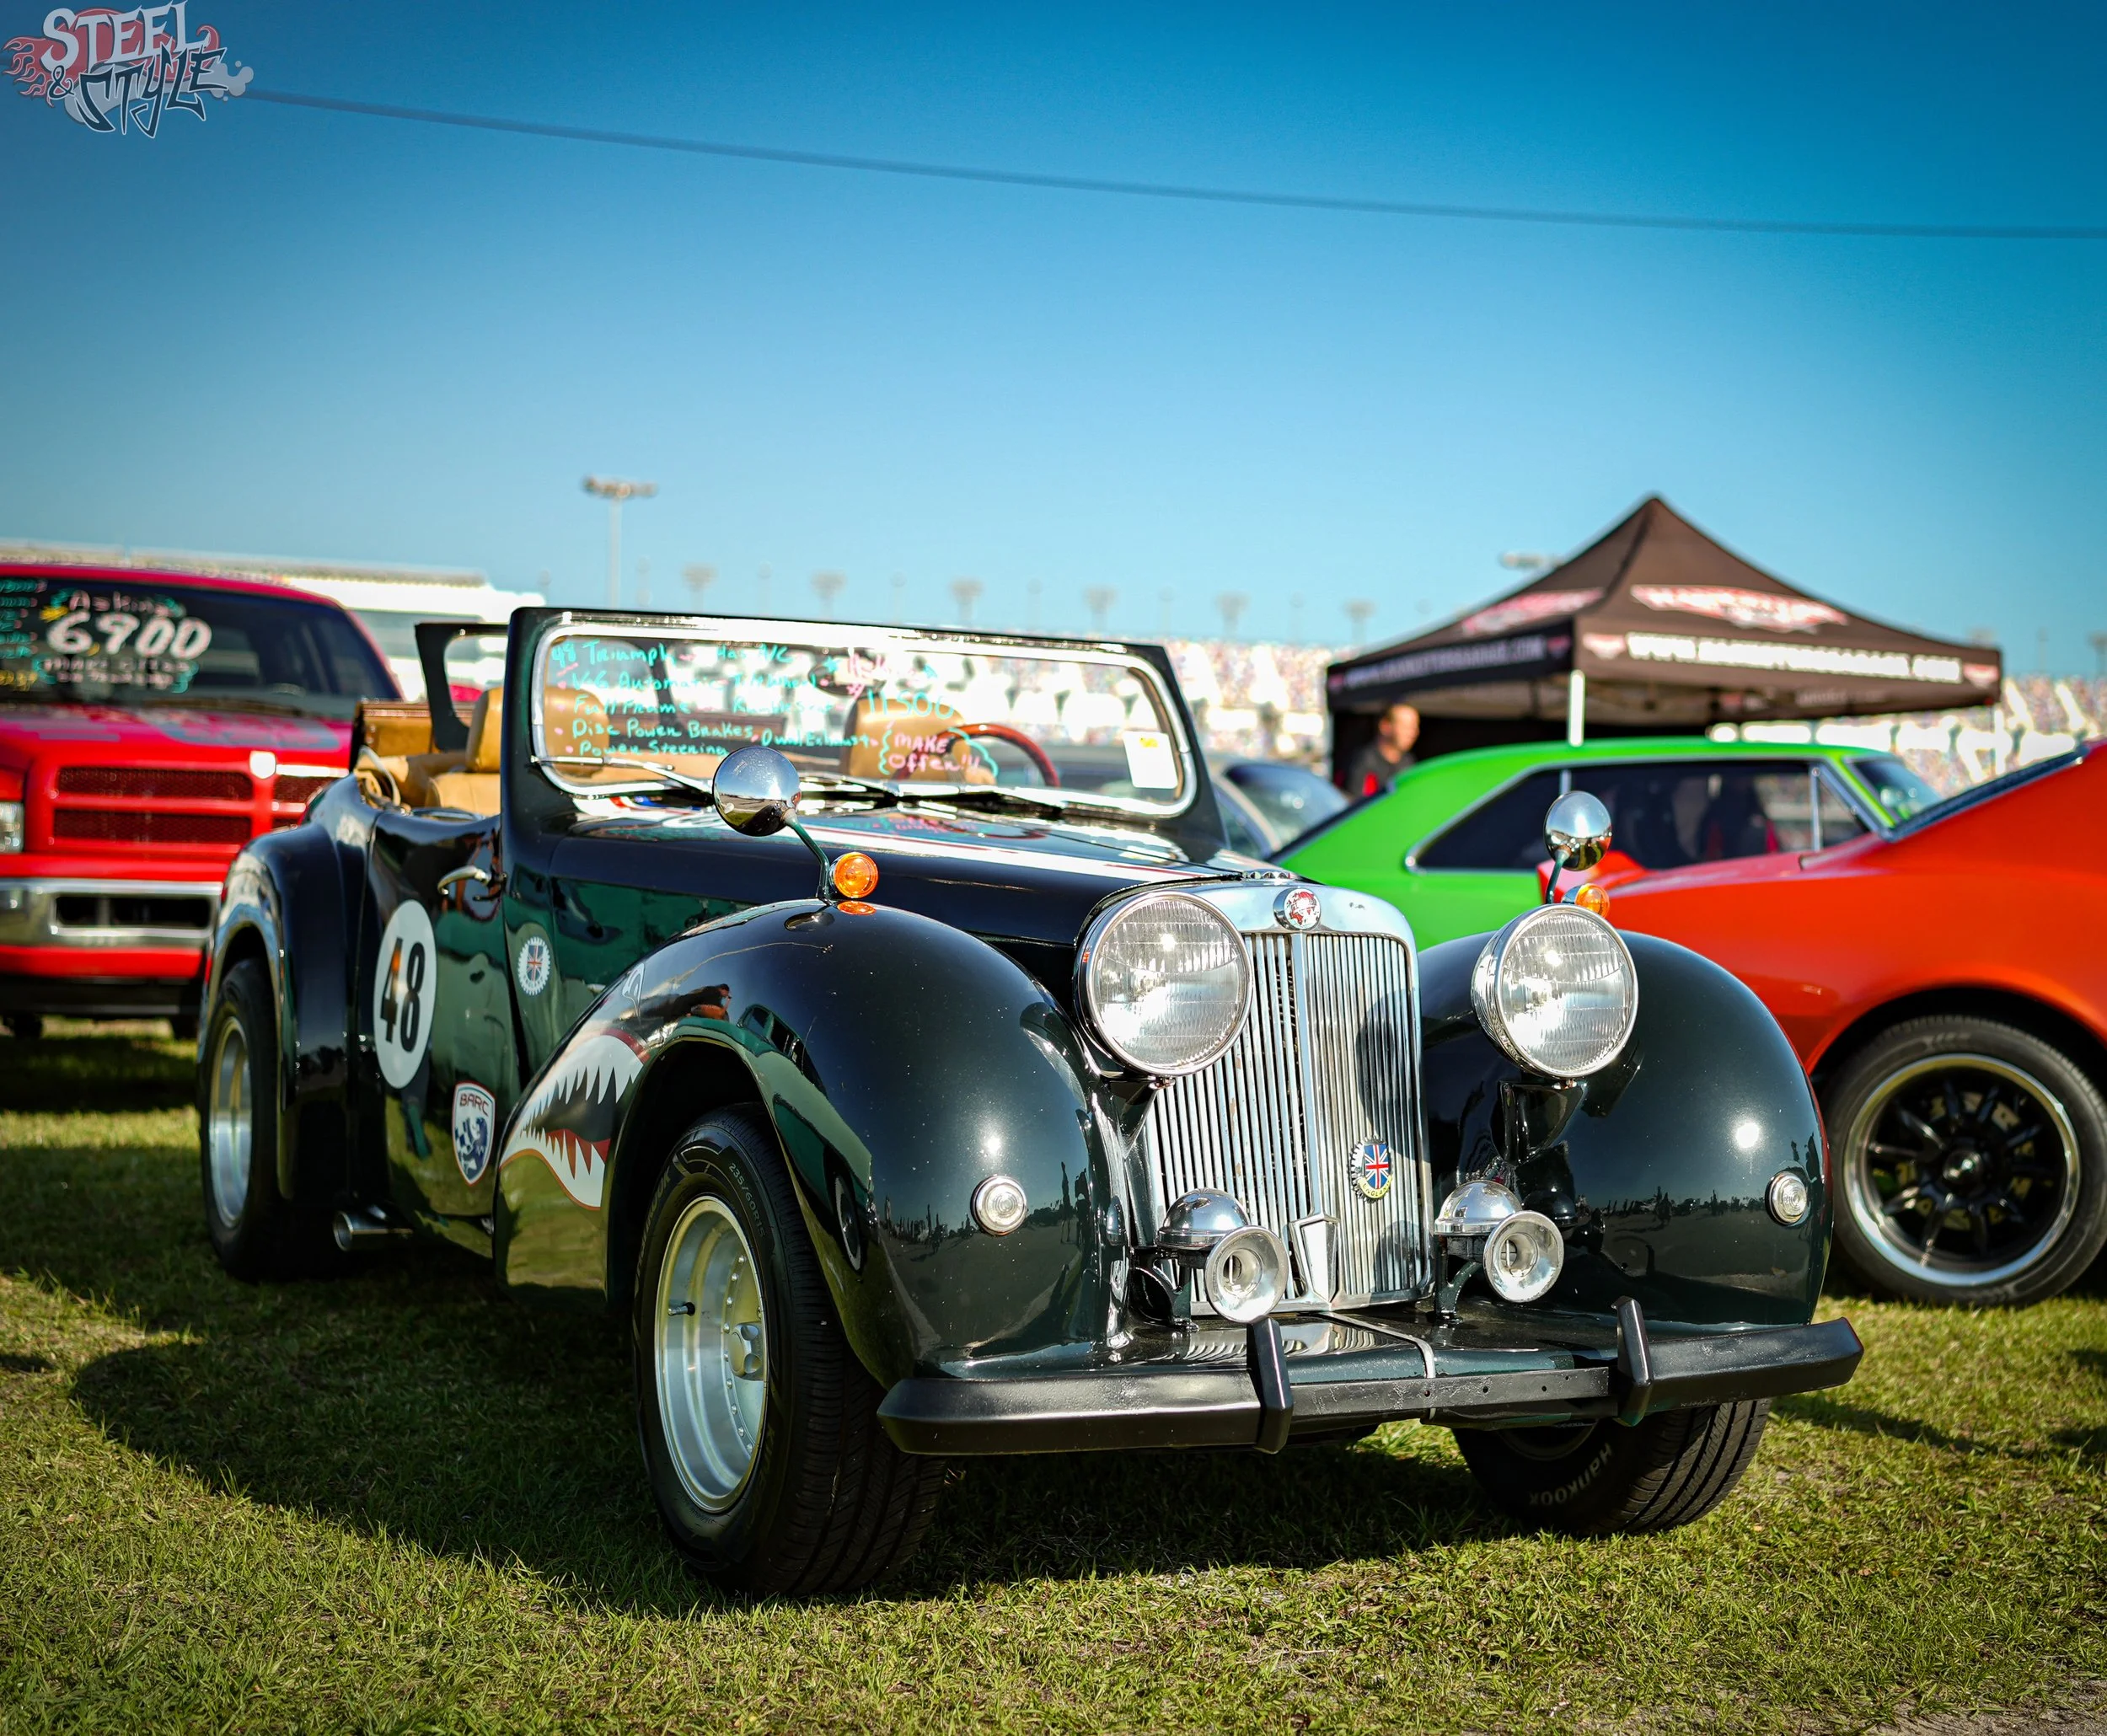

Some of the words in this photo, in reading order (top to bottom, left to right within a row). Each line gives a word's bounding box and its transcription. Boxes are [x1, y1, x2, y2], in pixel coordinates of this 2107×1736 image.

[47, 610, 212, 661] 6900
[572, 719, 621, 738] Disc
[380, 936, 426, 1053] 48
[459, 1092, 490, 1117] BARC
